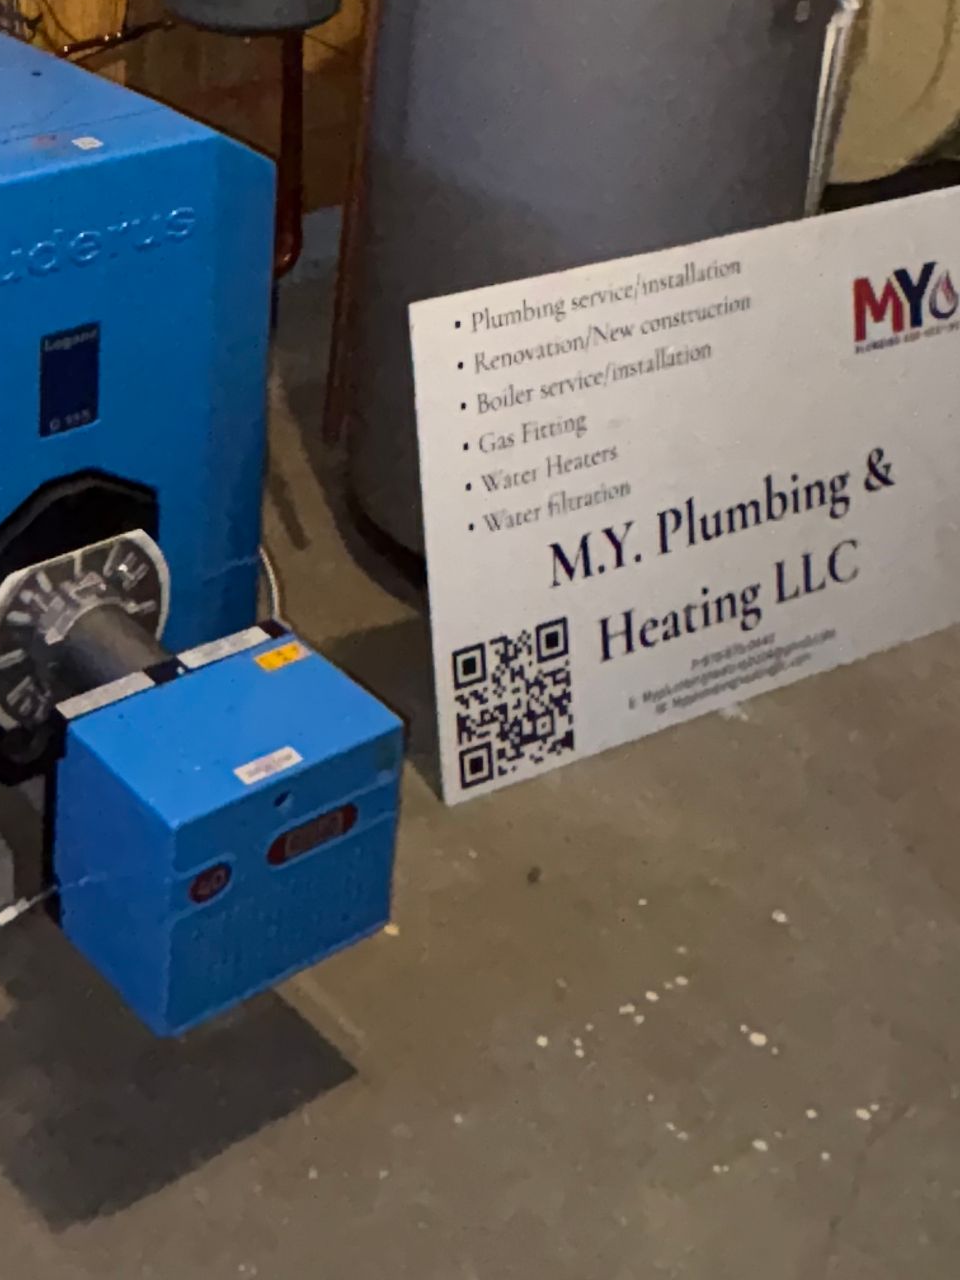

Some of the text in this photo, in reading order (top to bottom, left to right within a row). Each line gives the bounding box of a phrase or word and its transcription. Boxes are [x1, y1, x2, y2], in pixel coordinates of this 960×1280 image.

[470, 260, 742, 332] Plumbing service/installation
[473, 294, 751, 374] Renovation/New construction
[477, 343, 712, 414] Boiler service/installation
[478, 414, 588, 454] Gas Fitting
[481, 444, 619, 492] Water Heaters
[482, 479, 632, 532] Water filtration
[548, 447, 895, 589] M.Y. Plumbing &
[599, 582, 763, 663] Heating
[775, 538, 861, 604] LLC
